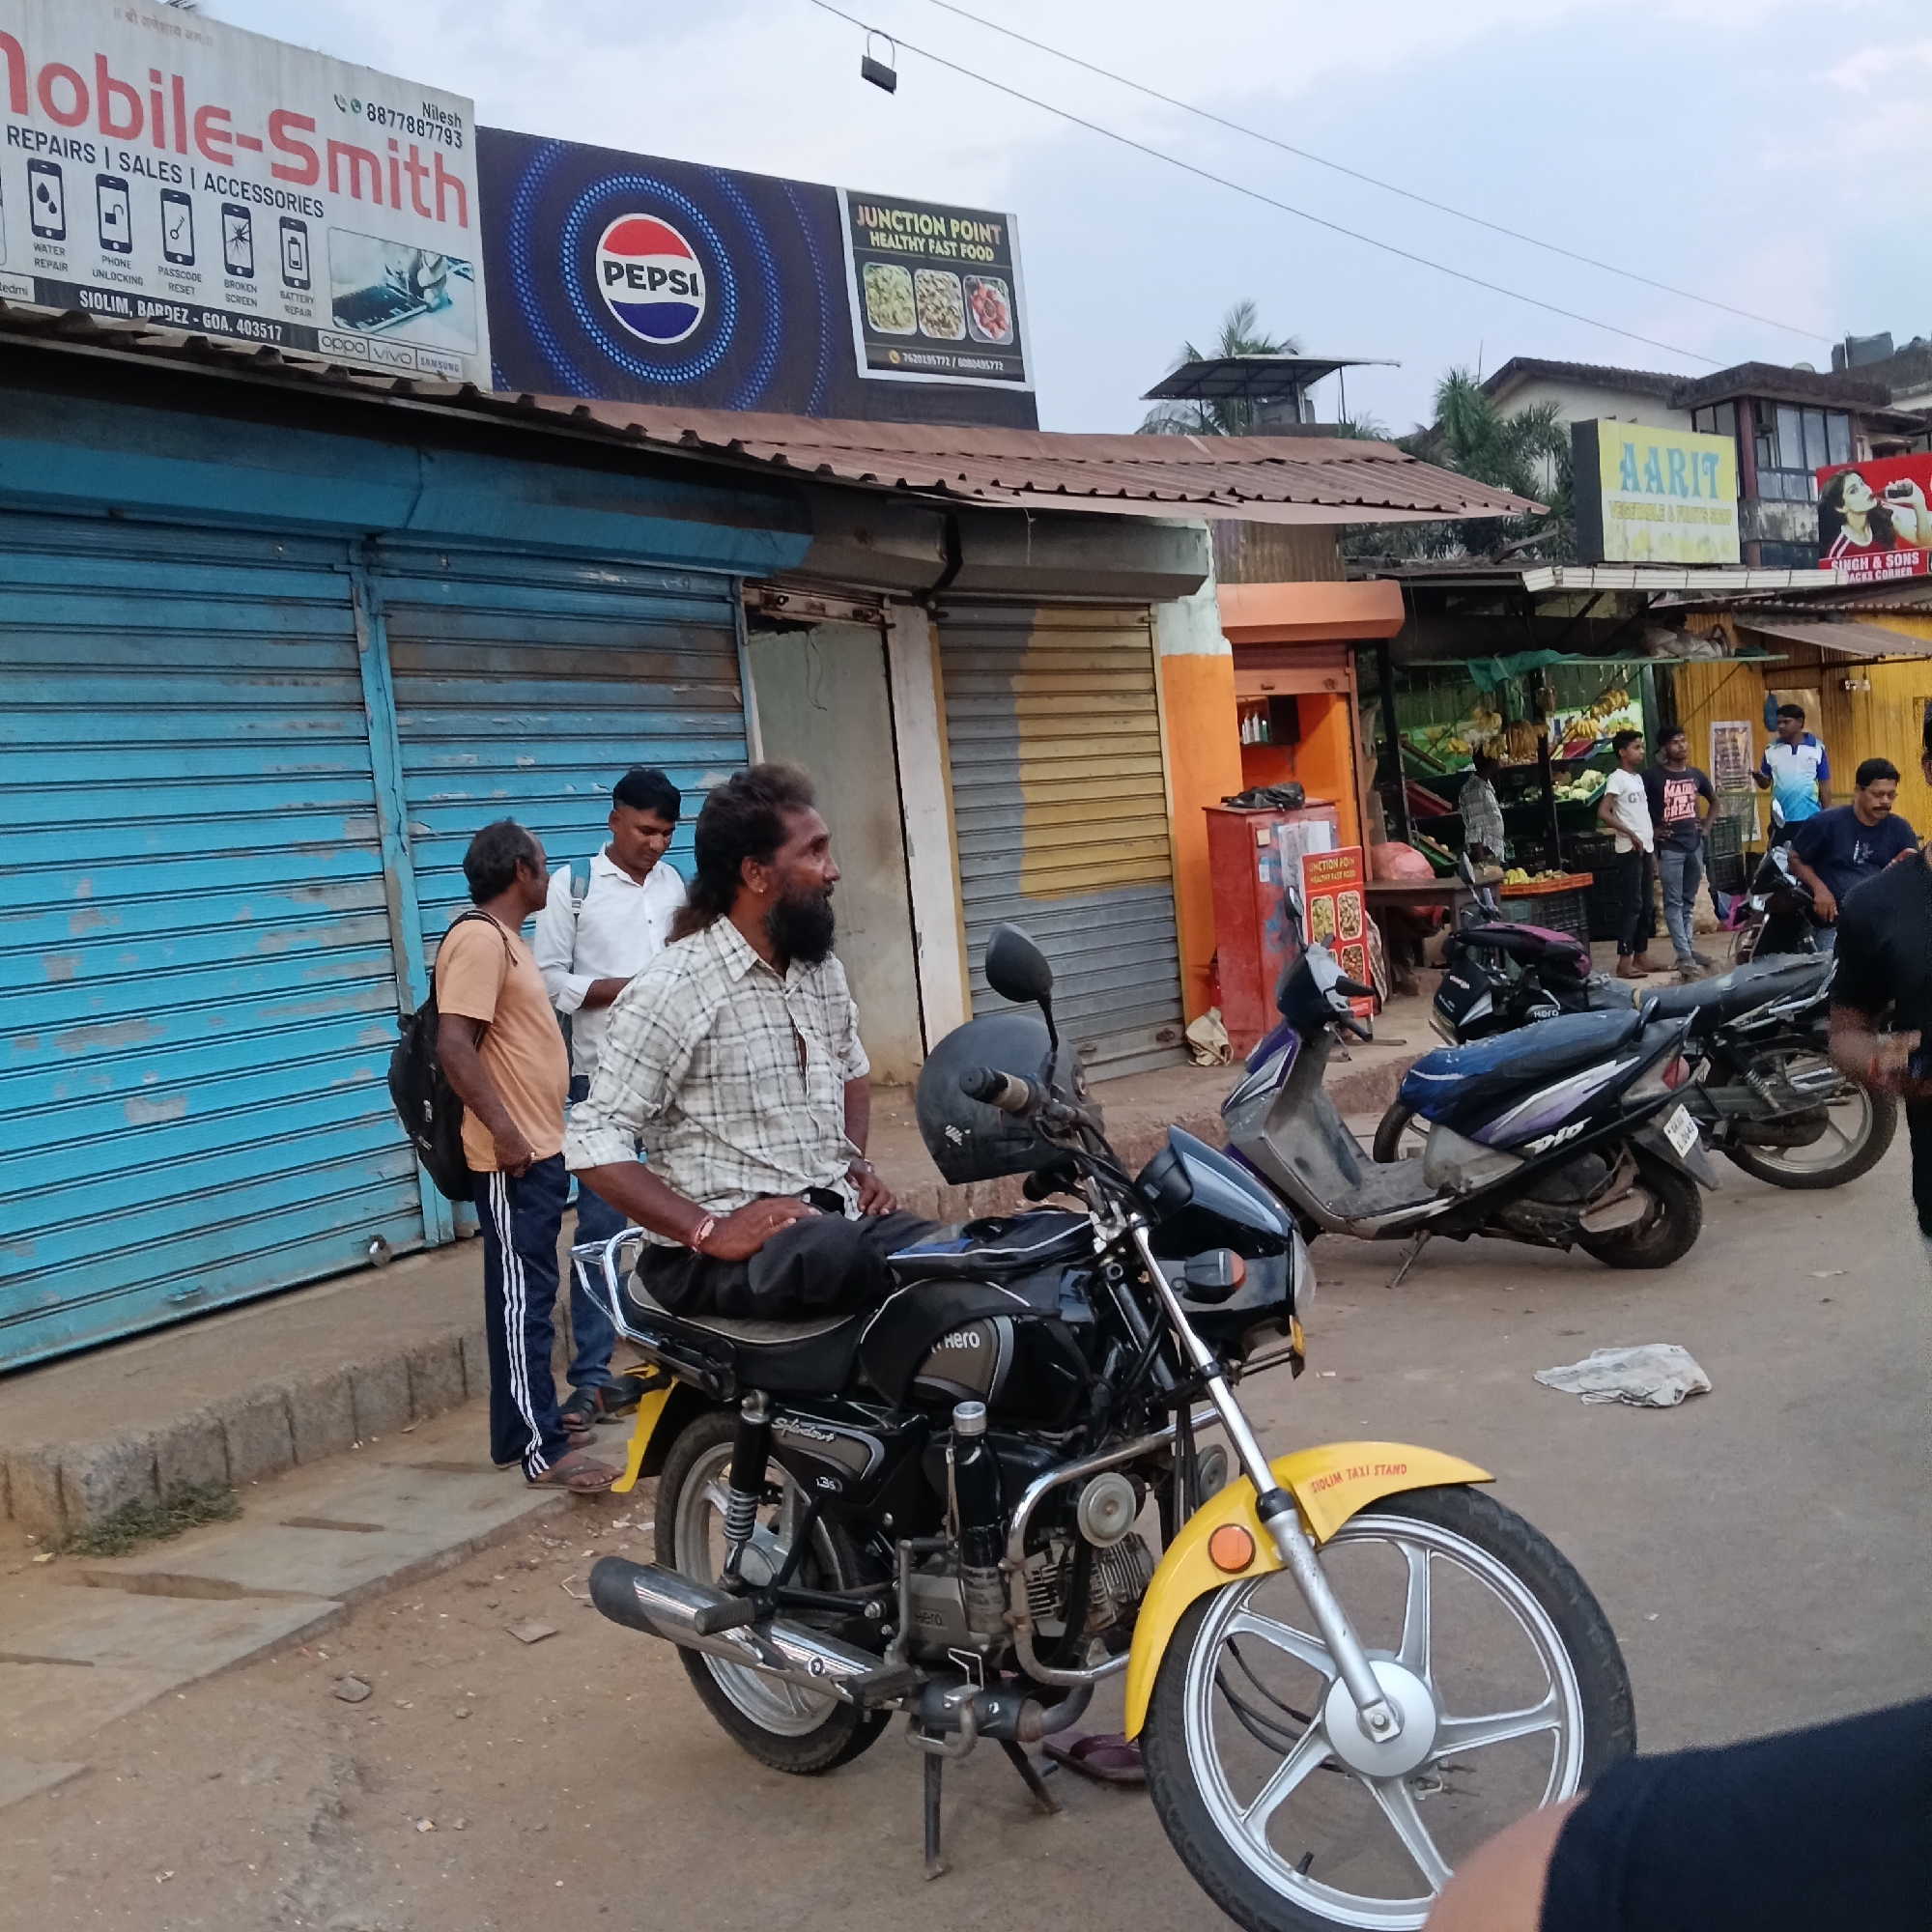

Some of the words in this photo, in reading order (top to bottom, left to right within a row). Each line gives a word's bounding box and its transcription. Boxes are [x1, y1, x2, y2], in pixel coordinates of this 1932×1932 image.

[422, 100, 462, 128] Nilesh
[366, 102, 463, 149] 8877887793
[7, 125, 96, 164] REPAIRS
[119, 152, 183, 184] SALES
[204, 172, 325, 219] ACCESSORIES
[856, 205, 947, 238] JUNCTION
[950, 218, 1001, 244] POINT
[33, 242, 67, 257] WATER
[869, 231, 926, 253] HEALTHY
[928, 238, 957, 257] FAST
[960, 243, 995, 262] FOOD
[34, 257, 69, 272] REPAIR
[101, 254, 132, 270] PHONE
[92, 269, 144, 287] UNLOCKING
[157, 265, 203, 283] PASSCODE
[603, 260, 699, 298] PEPSI
[168, 282, 196, 297] RESET
[223, 278, 258, 294] BROKEN
[225, 294, 258, 308] SCREEN
[279, 290, 315, 305] BATTERY
[79, 290, 133, 318] SIOLIM,
[137, 299, 189, 325] BARDEZ
[202, 312, 234, 332] GOA.
[236, 318, 283, 341] 403517
[284, 305, 313, 319] REPAIR
[373, 346, 412, 365] vivo
[420, 356, 460, 373] SAMSUNG
[1619, 442, 1719, 499] AARIT
[1608, 500, 1665, 523] VEGETABLE
[1832, 556, 1869, 572] SINGH
[1872, 555, 1883, 570] &
[1885, 552, 1919, 568] SONS
[1846, 571, 1874, 583] ACKS
[944, 1331, 980, 1349] Hero
[1311, 1470, 1343, 1493] SIOLIM
[1346, 1464, 1370, 1480] TAXI
[1374, 1463, 1407, 1477] STAND
